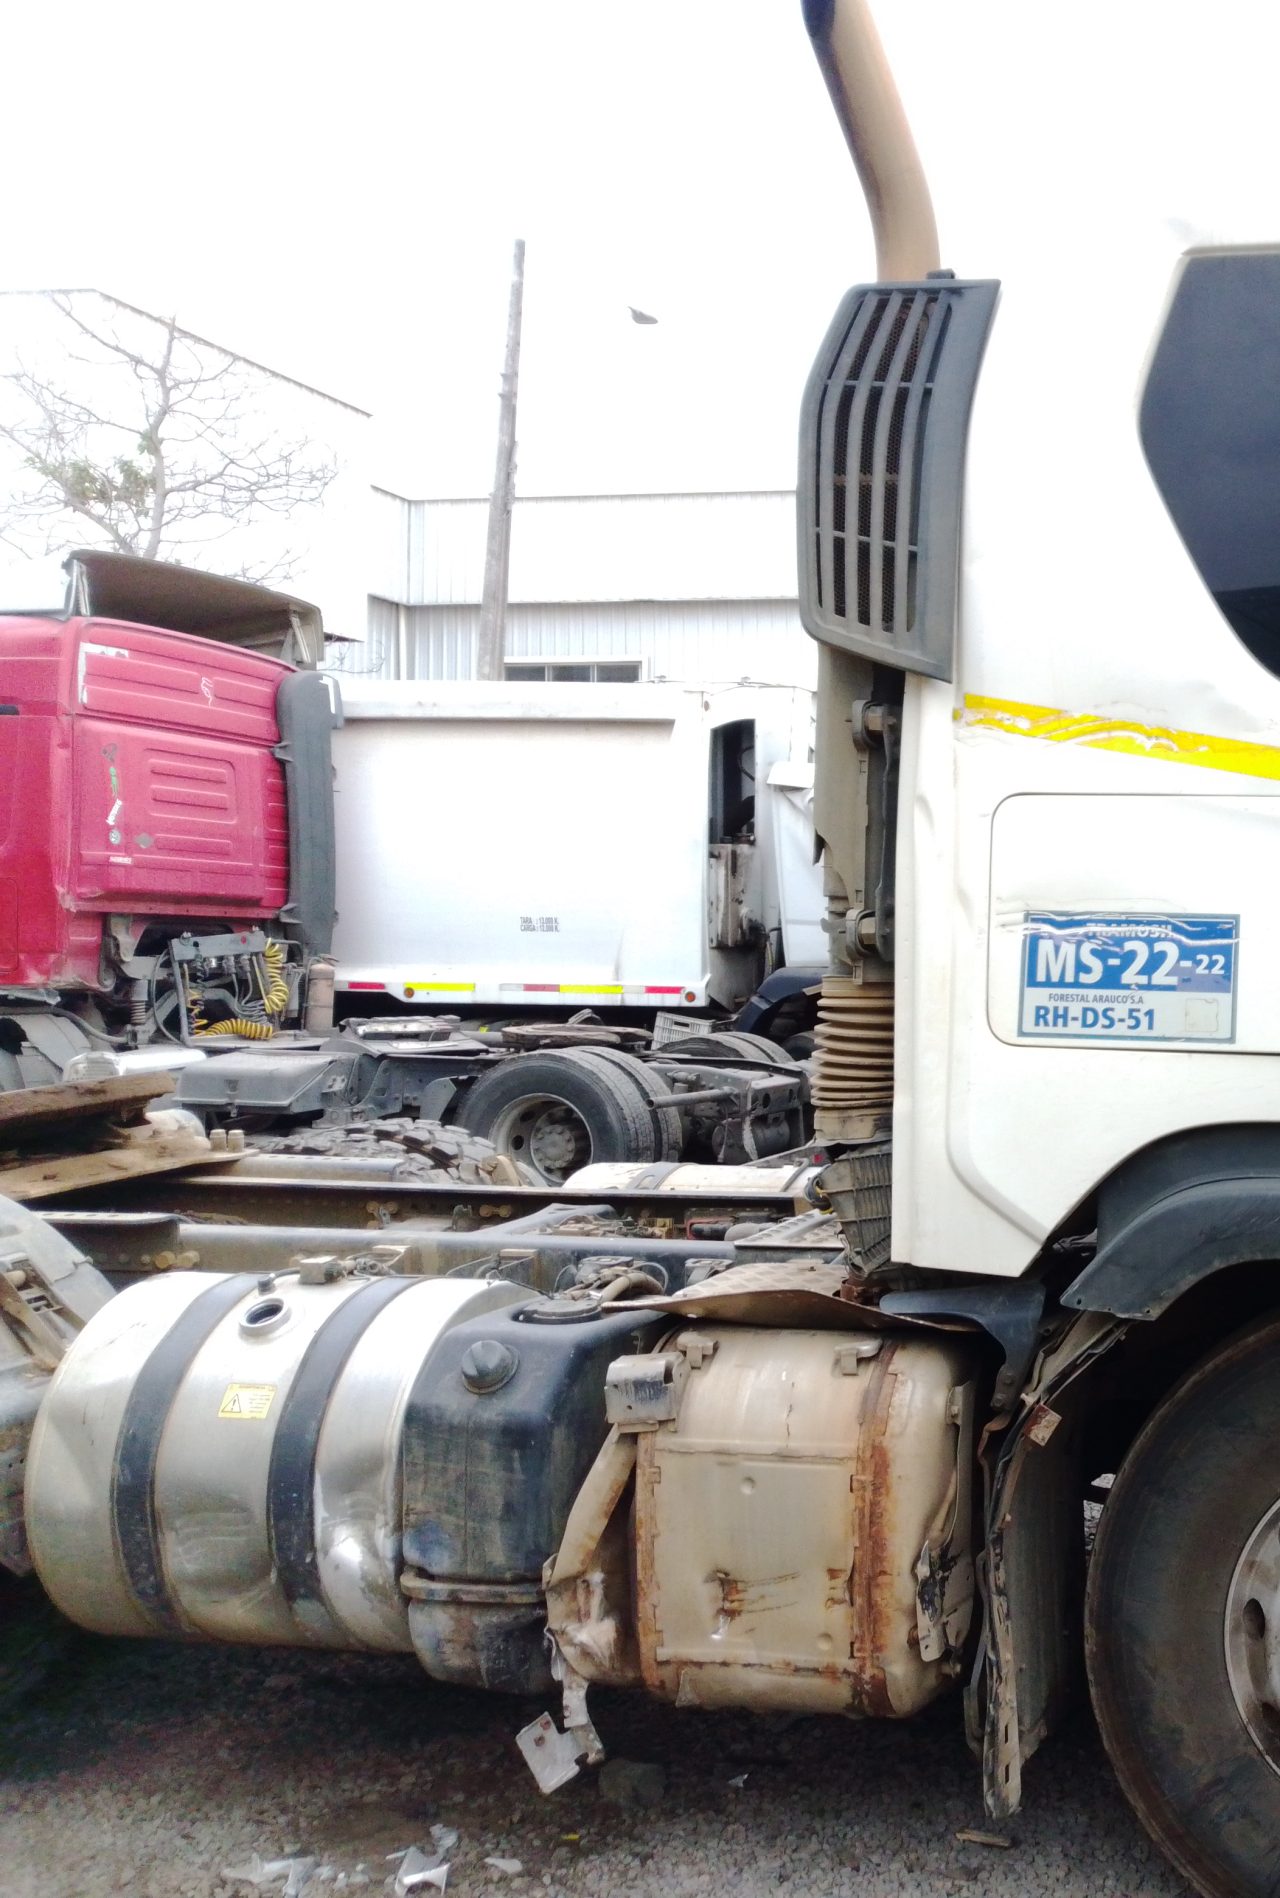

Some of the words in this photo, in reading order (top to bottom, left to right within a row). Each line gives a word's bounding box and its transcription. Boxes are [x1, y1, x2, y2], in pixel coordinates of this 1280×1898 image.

[1048, 992, 1091, 1004] FORESTAL
[1092, 993, 1129, 1005] ARAUCO
[1033, 1005, 1156, 1031] RH-DS-51
